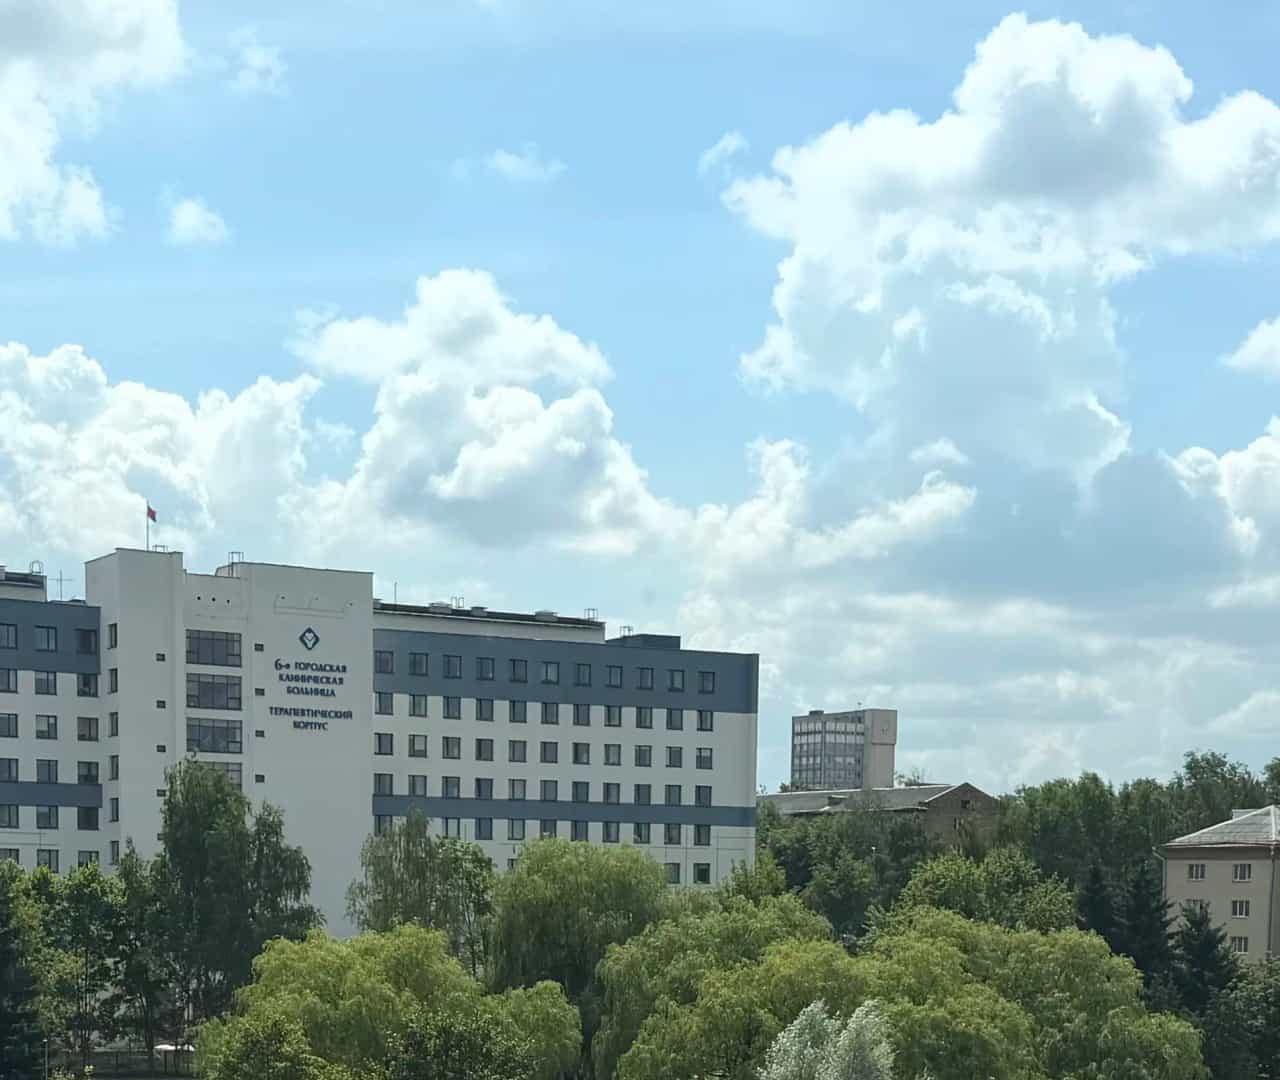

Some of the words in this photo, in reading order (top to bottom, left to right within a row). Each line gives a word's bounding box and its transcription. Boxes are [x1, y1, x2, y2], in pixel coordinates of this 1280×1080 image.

[294, 661, 347, 673] ГОРОДСКАЯ
[278, 674, 344, 686] КЛИНИЧЕСКАЯ
[286, 686, 336, 697] БОЛЬНИЦА
[293, 721, 328, 731] КОРПУС
